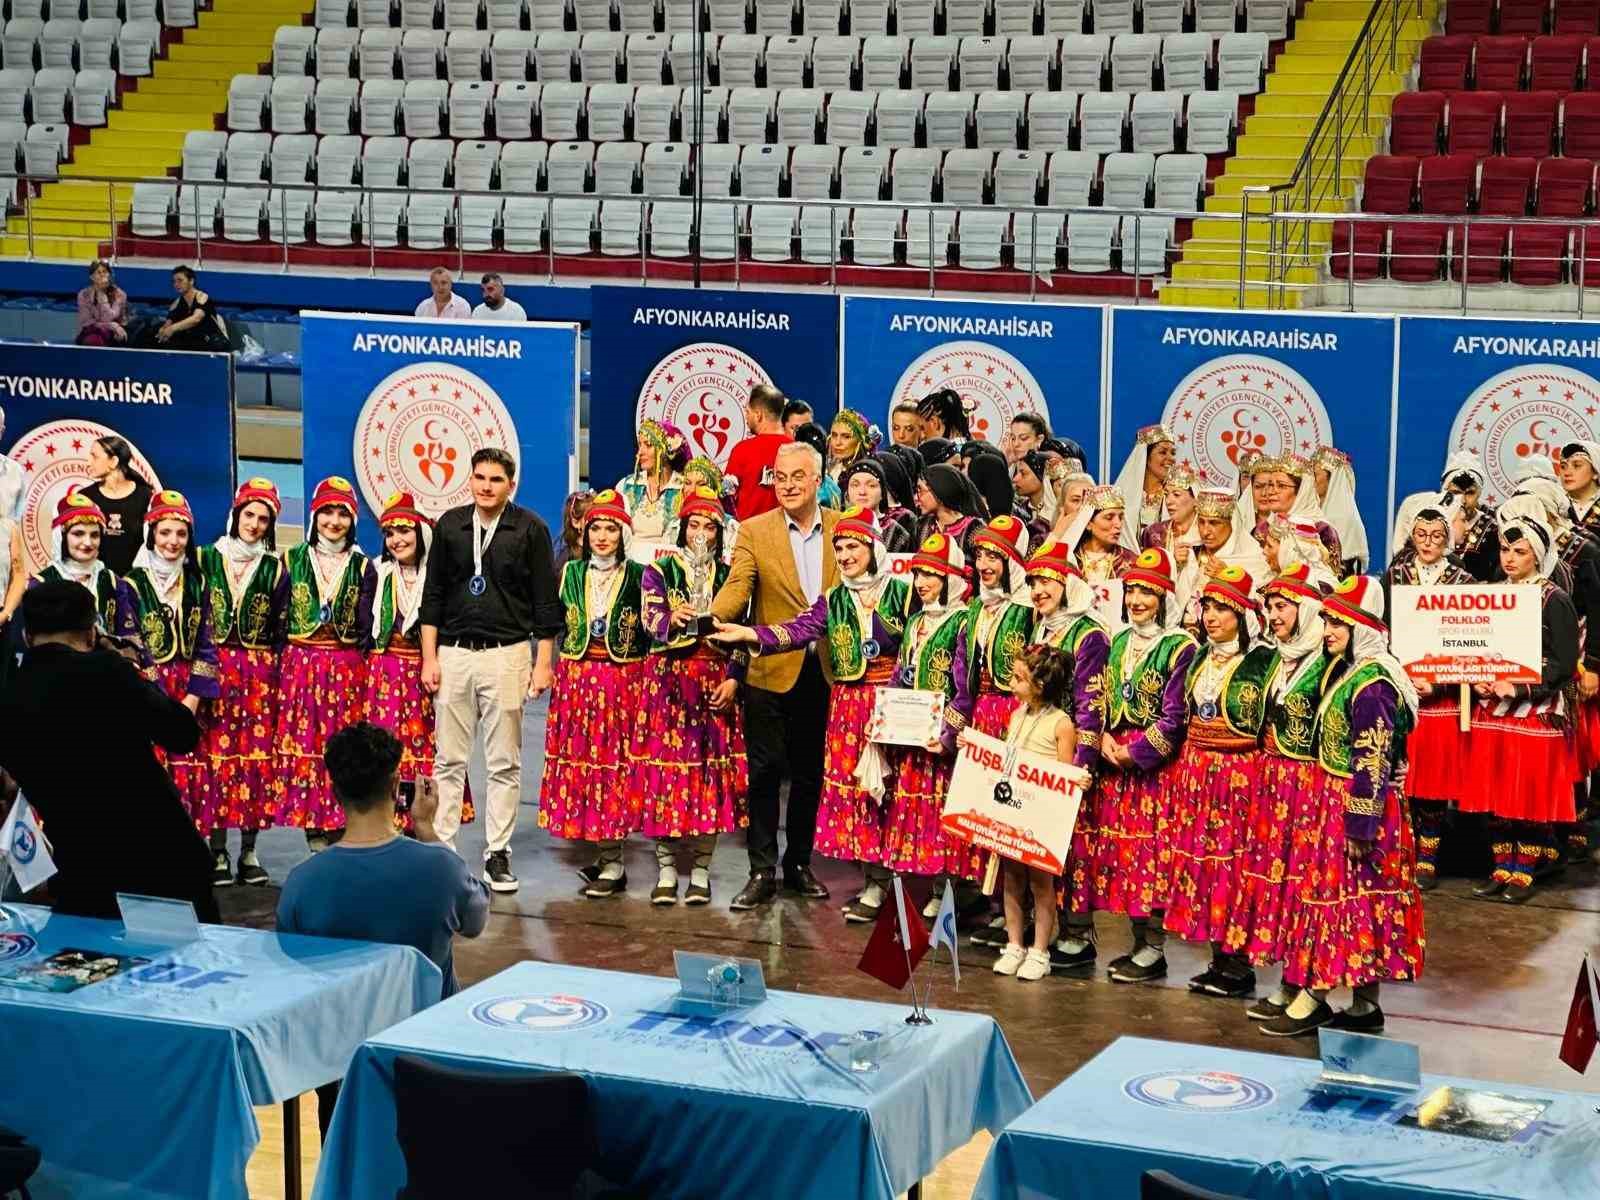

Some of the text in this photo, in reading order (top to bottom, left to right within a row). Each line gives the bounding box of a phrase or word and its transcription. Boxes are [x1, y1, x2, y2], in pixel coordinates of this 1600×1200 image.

[633, 308, 790, 331] AFYONKARAHİSAR
[889, 314, 1053, 338] AFYONKARAHİSAR
[353, 333, 522, 360] AFYONKARAHİSAR
[1162, 327, 1338, 351] AFYONKARAHİSAR
[1453, 335, 1600, 358] AFYONKARAHİ
[0, 375, 173, 406] FYONKARAHİSAR
[62, 463, 93, 477] GENÇ
[1415, 593, 1517, 611] ANADOLU
[1441, 615, 1490, 625] FOLKLOR
[1442, 637, 1488, 648] İSTANBUL
[964, 742, 1010, 775] TUŞB
[1016, 763, 1079, 797] SANAT
